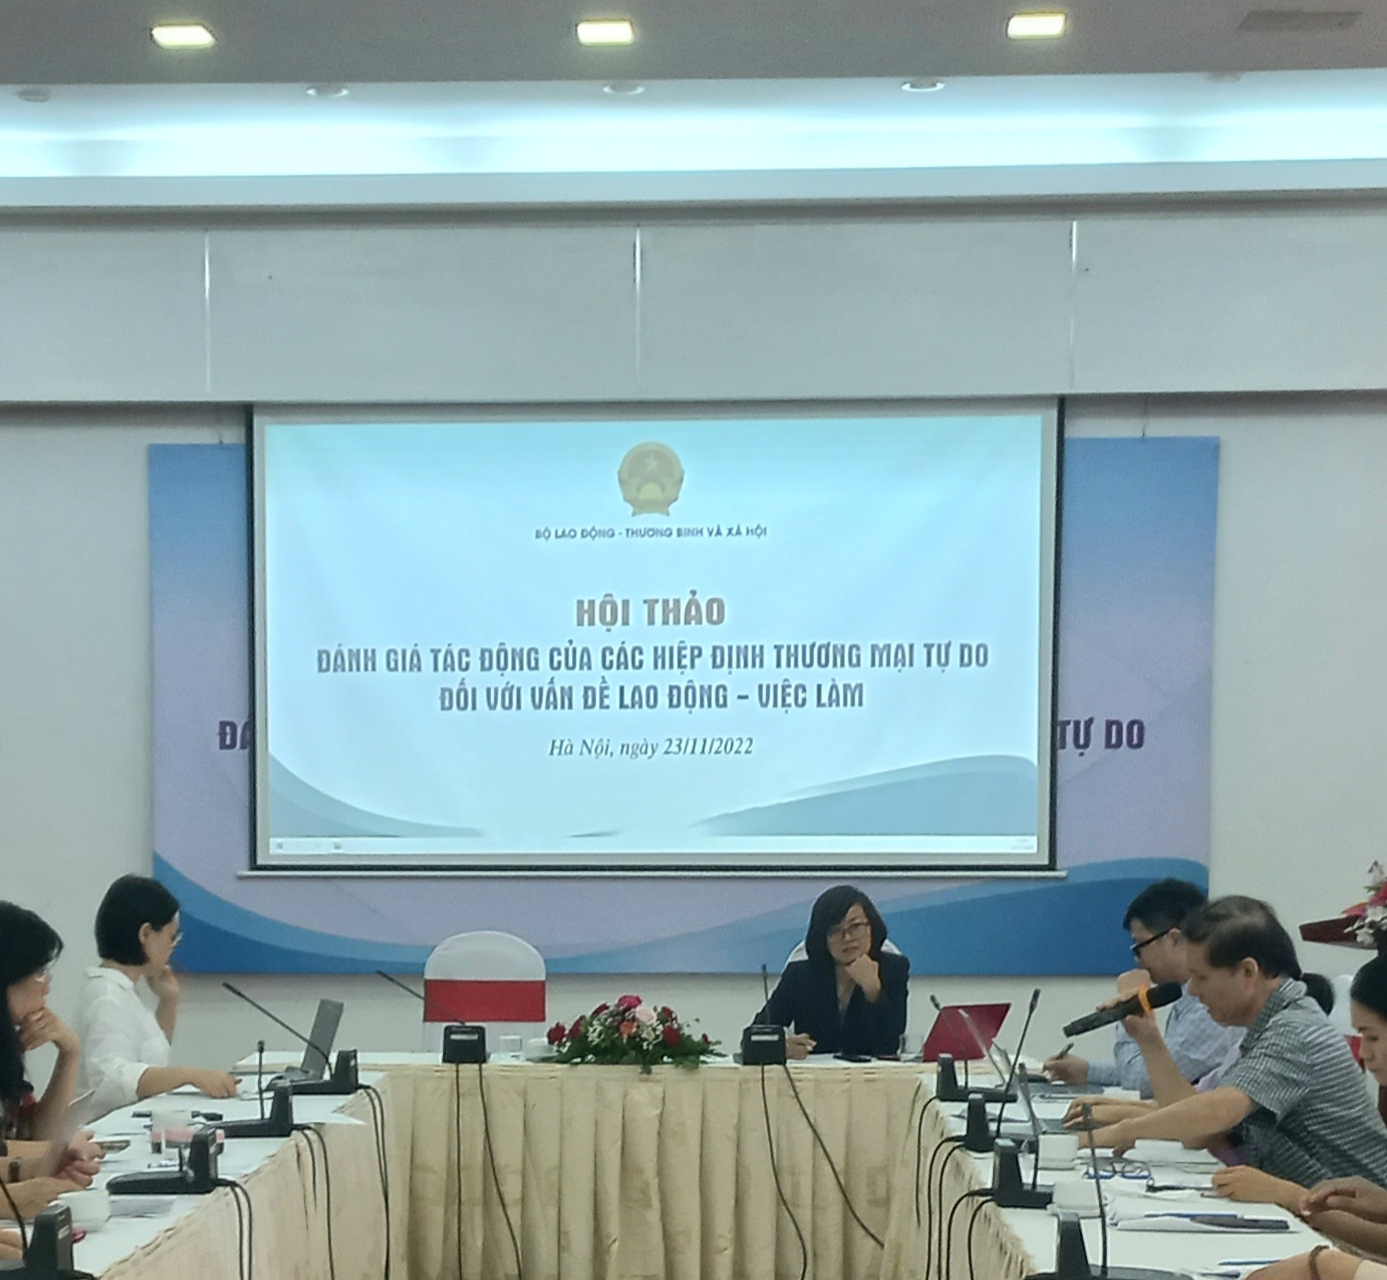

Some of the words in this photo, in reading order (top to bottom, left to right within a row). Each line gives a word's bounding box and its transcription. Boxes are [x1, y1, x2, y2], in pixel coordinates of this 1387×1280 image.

[535, 526, 551, 542] BỘ
[555, 529, 577, 540] LAO
[626, 526, 672, 538] THƯƠNG
[676, 527, 703, 538] BINH
[746, 524, 767, 539] HỘI
[576, 593, 631, 633] HỘI
[643, 590, 726, 627] THẢO
[316, 643, 377, 673] ĐÁNH
[385, 643, 422, 673] GIÁ
[430, 643, 471, 673] TÁC
[479, 642, 540, 677] ĐỘNG
[549, 639, 592, 671] CỦA
[601, 641, 644, 671] CÁC
[653, 640, 703, 675] HIỆP
[710, 644, 765, 675] ĐỊNH
[774, 641, 861, 669] THƯƠNG
[870, 642, 914, 673] MẠI
[923, 640, 952, 673] TỰ
[958, 643, 989, 668] DO
[439, 677, 477, 712] ĐỐI
[486, 680, 522, 711] VỚI
[530, 675, 573, 711] VẤN
[582, 675, 611, 710] ĐỀ
[618, 685, 659, 710] LAO
[667, 679, 728, 714] ĐỘNG
[758, 678, 807, 714] VIỆC
[816, 678, 864, 709] LÀM
[549, 738, 574, 756] Hà
[579, 738, 614, 758] Nội,
[619, 739, 659, 760] ngày
[663, 737, 754, 756] 23/11/2022
[1057, 716, 1094, 757] TỰ
[1104, 719, 1145, 750] DO
